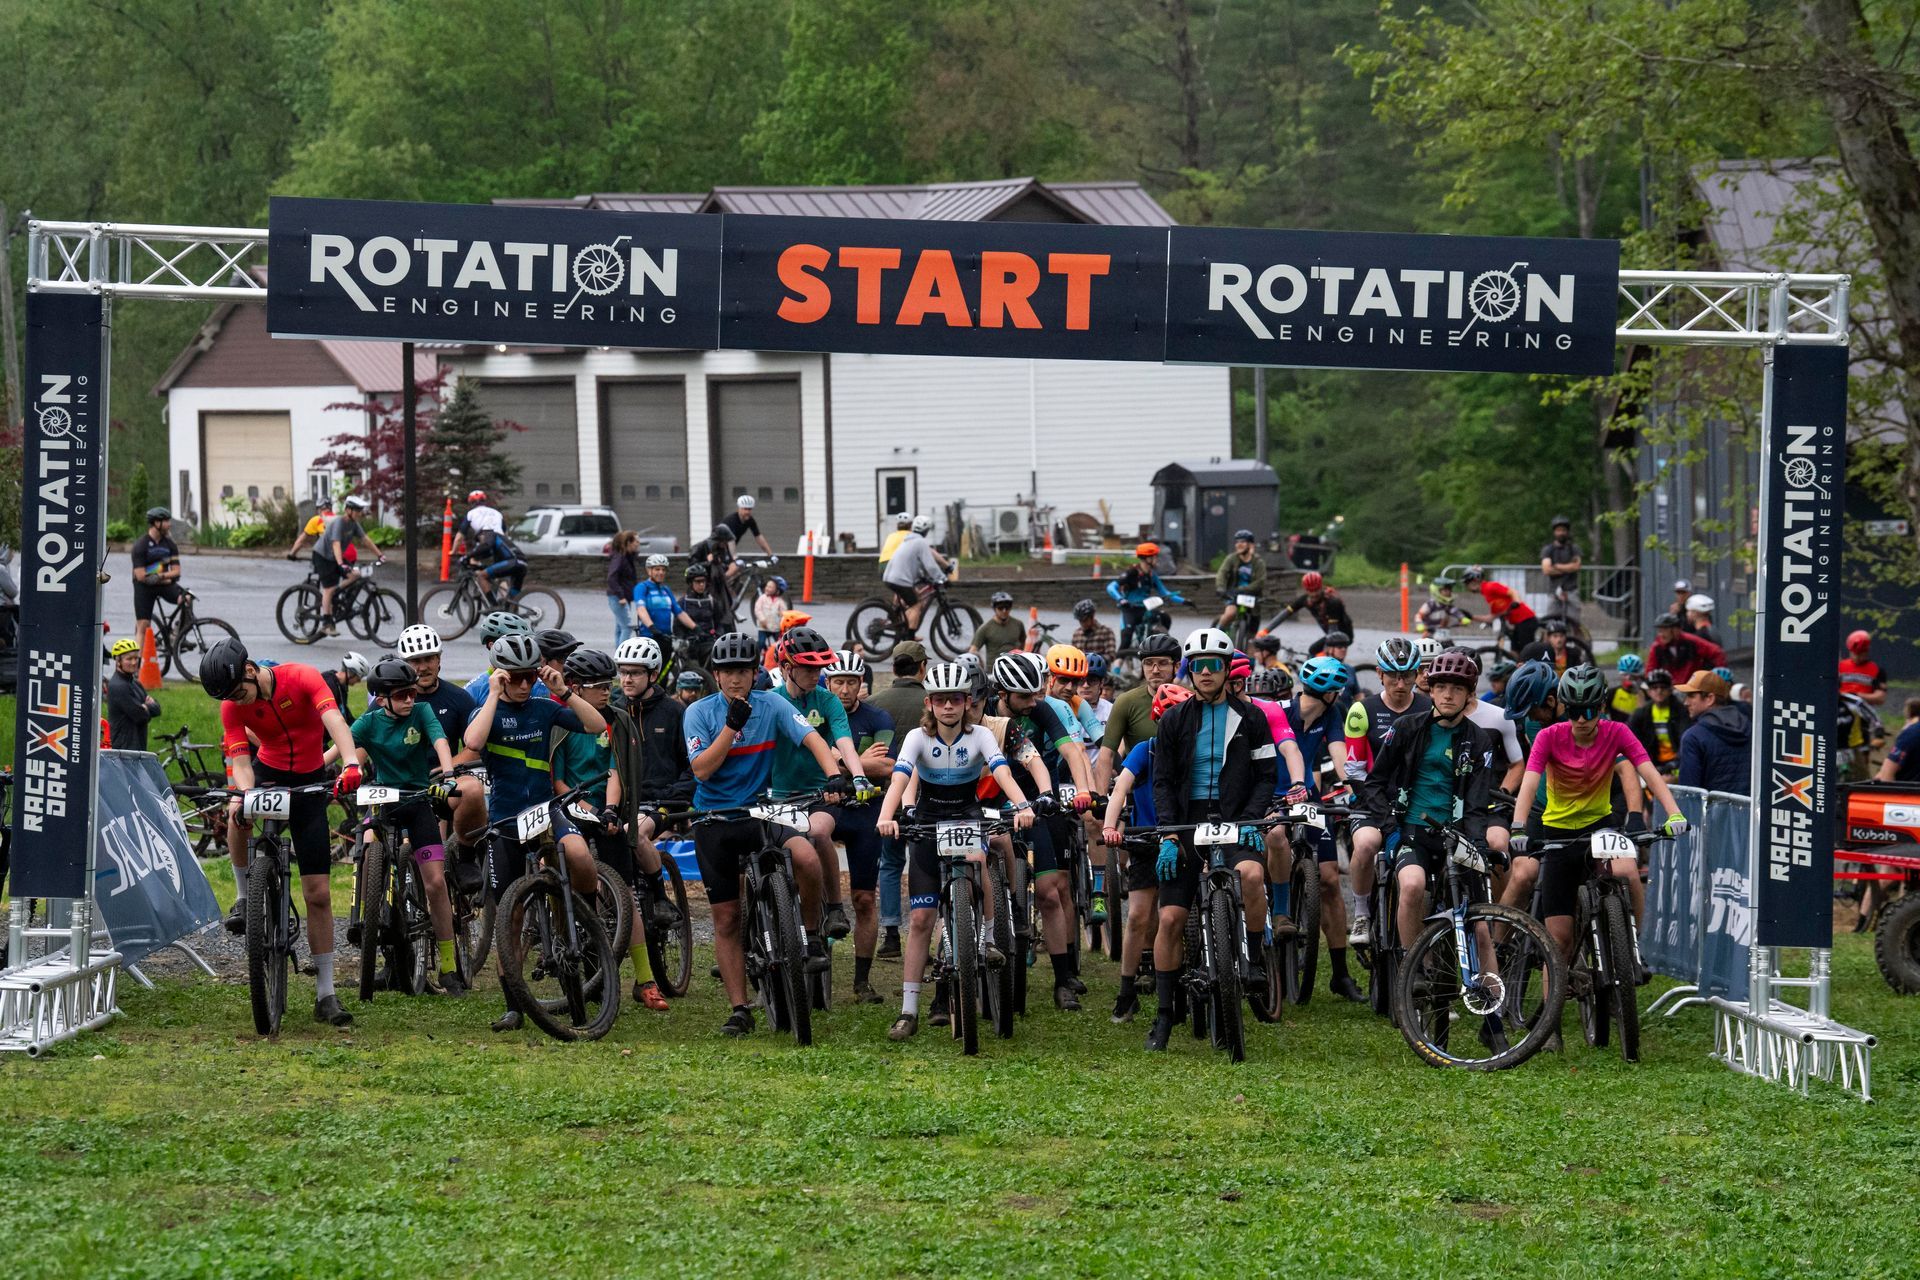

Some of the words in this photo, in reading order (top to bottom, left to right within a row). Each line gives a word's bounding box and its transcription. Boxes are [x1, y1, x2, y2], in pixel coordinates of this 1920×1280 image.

[310, 233, 678, 312] ROTATION
[777, 243, 1111, 330] START
[1208, 261, 1575, 340] ROTATION
[383, 296, 677, 324] ENGINEERING
[1279, 324, 1572, 350] ENGINEERING
[35, 374, 84, 592] ROTATION
[74, 375, 88, 550] ENGINEERING
[1780, 425, 1828, 643] ROTATION
[1817, 426, 1834, 600] ENGINEERING
[26, 678, 71, 762] XC
[71, 685, 83, 764] CHAMPIONSHIP
[515, 729, 543, 740] riverside
[23, 758, 46, 833] RACE
[46, 761, 68, 818] DAY
[368, 788, 388, 799] 29
[1771, 728, 1815, 811] XC
[1816, 735, 1827, 814] CHAMPIONSHIP
[254, 793, 282, 812] 152
[523, 806, 544, 829] 179
[1203, 824, 1231, 837] 137
[1300, 804, 1317, 820] 26
[1852, 828, 1898, 841] Kubota
[947, 827, 974, 847] 162
[1600, 834, 1629, 850] 178
[1770, 808, 1791, 882] RACE
[1792, 811, 1813, 867] DAY
